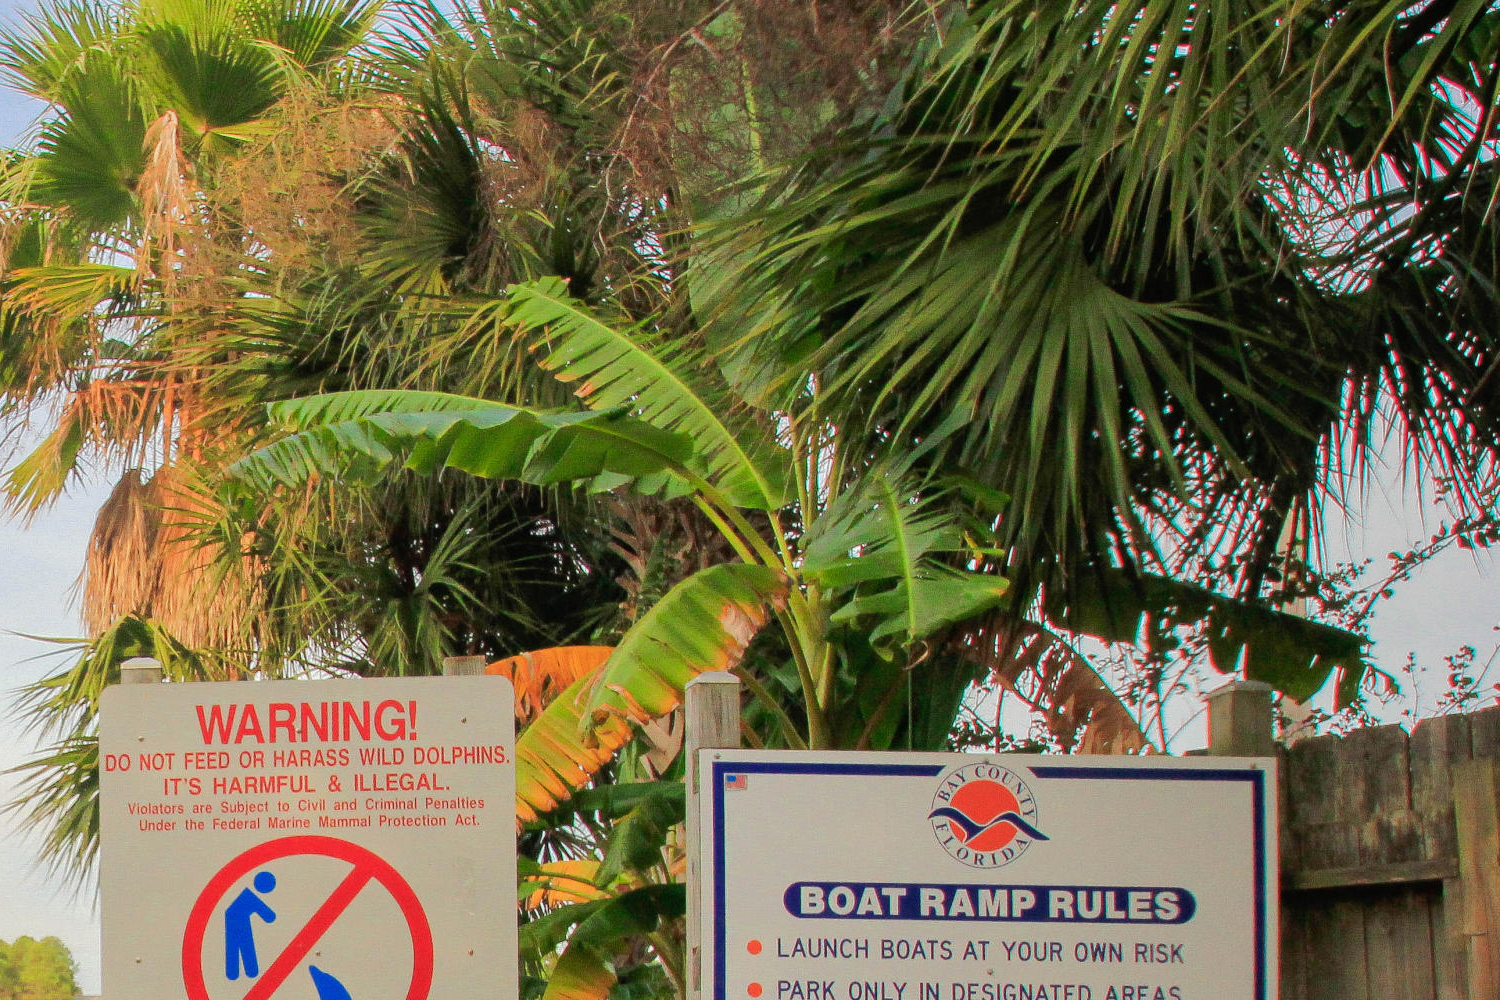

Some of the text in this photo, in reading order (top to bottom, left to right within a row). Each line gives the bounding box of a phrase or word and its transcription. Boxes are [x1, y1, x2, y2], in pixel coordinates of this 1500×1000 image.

[196, 701, 417, 744] WARNING!
[106, 745, 510, 771] DO NOT FEED OR HARASS WILD DOLPHINS.
[164, 773, 449, 795] IT'S HARMFUL & ILLEGAL.
[937, 766, 1035, 817] BAY COUNTY
[128, 798, 485, 815] Violators are Subject to Civil and Criminal Penalties
[139, 814, 480, 831] Under the Federal Marine Mammal Protection Act.
[936, 824, 1028, 865] FLORIDA
[800, 886, 1181, 920] BOAT RAMP RULES
[778, 939, 1185, 964] LAUNCH BOATS AT YOUR OWN RISK
[778, 980, 835, 1000] PARK
